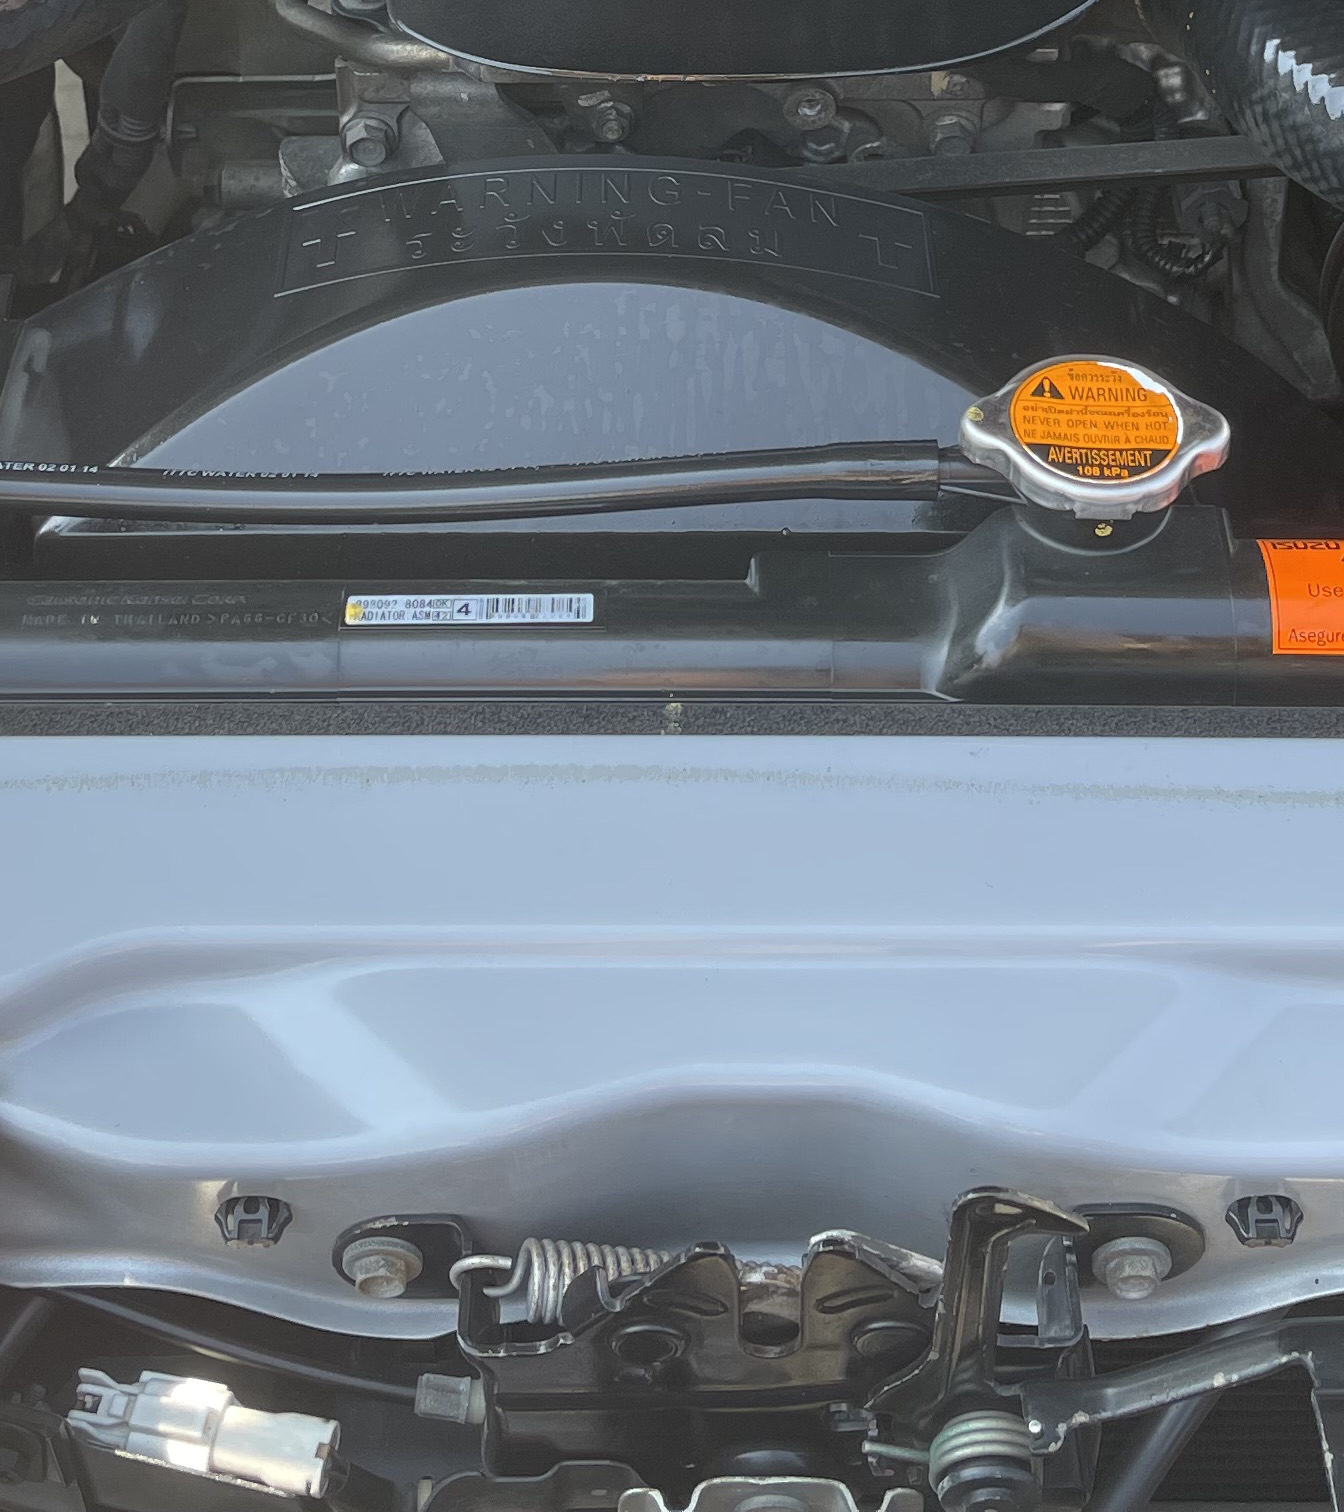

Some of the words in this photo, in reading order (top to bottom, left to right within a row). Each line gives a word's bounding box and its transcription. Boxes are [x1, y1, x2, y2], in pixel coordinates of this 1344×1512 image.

[1068, 386, 1147, 402] WARNING
[1023, 415, 1060, 428] NEVER
[1066, 418, 1097, 429] OPEN
[1103, 420, 1139, 431] WHEN
[1023, 428, 1037, 439] NE
[1040, 430, 1080, 443] JAMAIS
[1048, 445, 1152, 468] AVERTISSEMENT
[38, 462, 56, 472] 02
[59, 463, 76, 473] 01
[82, 464, 99, 474] 14
[1077, 466, 1100, 477] 108
[1104, 466, 1129, 478] kPa
[1271, 541, 1340, 550] ISUZU
[1307, 583, 1344, 598] Use
[457, 602, 471, 616] 4
